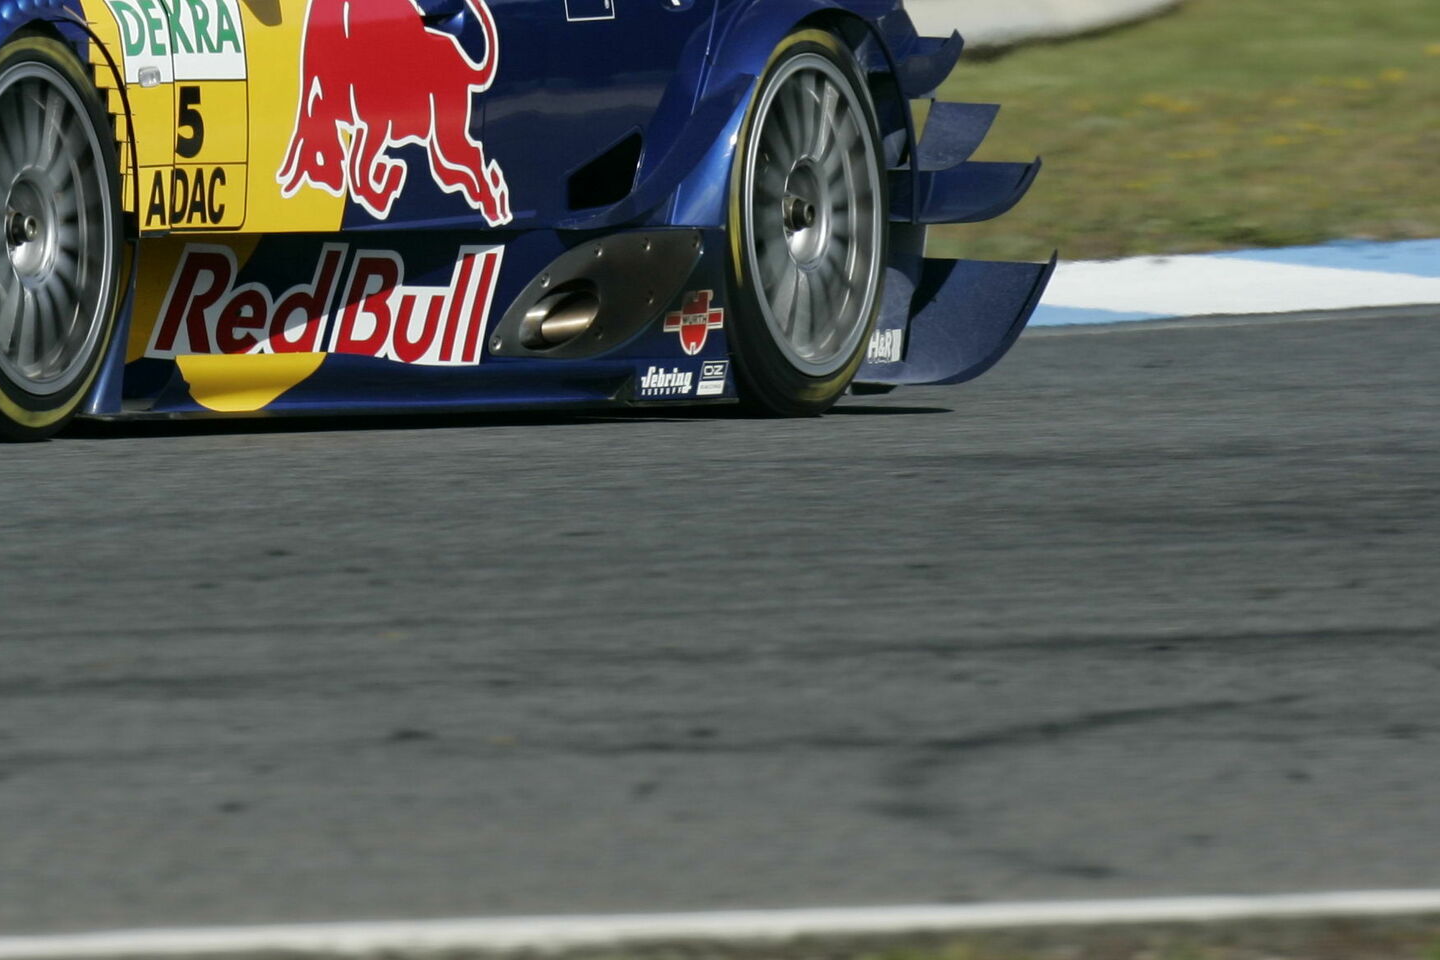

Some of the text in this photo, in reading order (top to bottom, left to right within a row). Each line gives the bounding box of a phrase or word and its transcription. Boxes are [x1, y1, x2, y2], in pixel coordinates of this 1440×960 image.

[175, 85, 204, 159] 5
[145, 166, 226, 225] ADAC
[148, 244, 502, 363] Red Bull
[867, 328, 892, 364] H&R
[640, 365, 693, 393] Sebring
[703, 364, 724, 376] OZ
